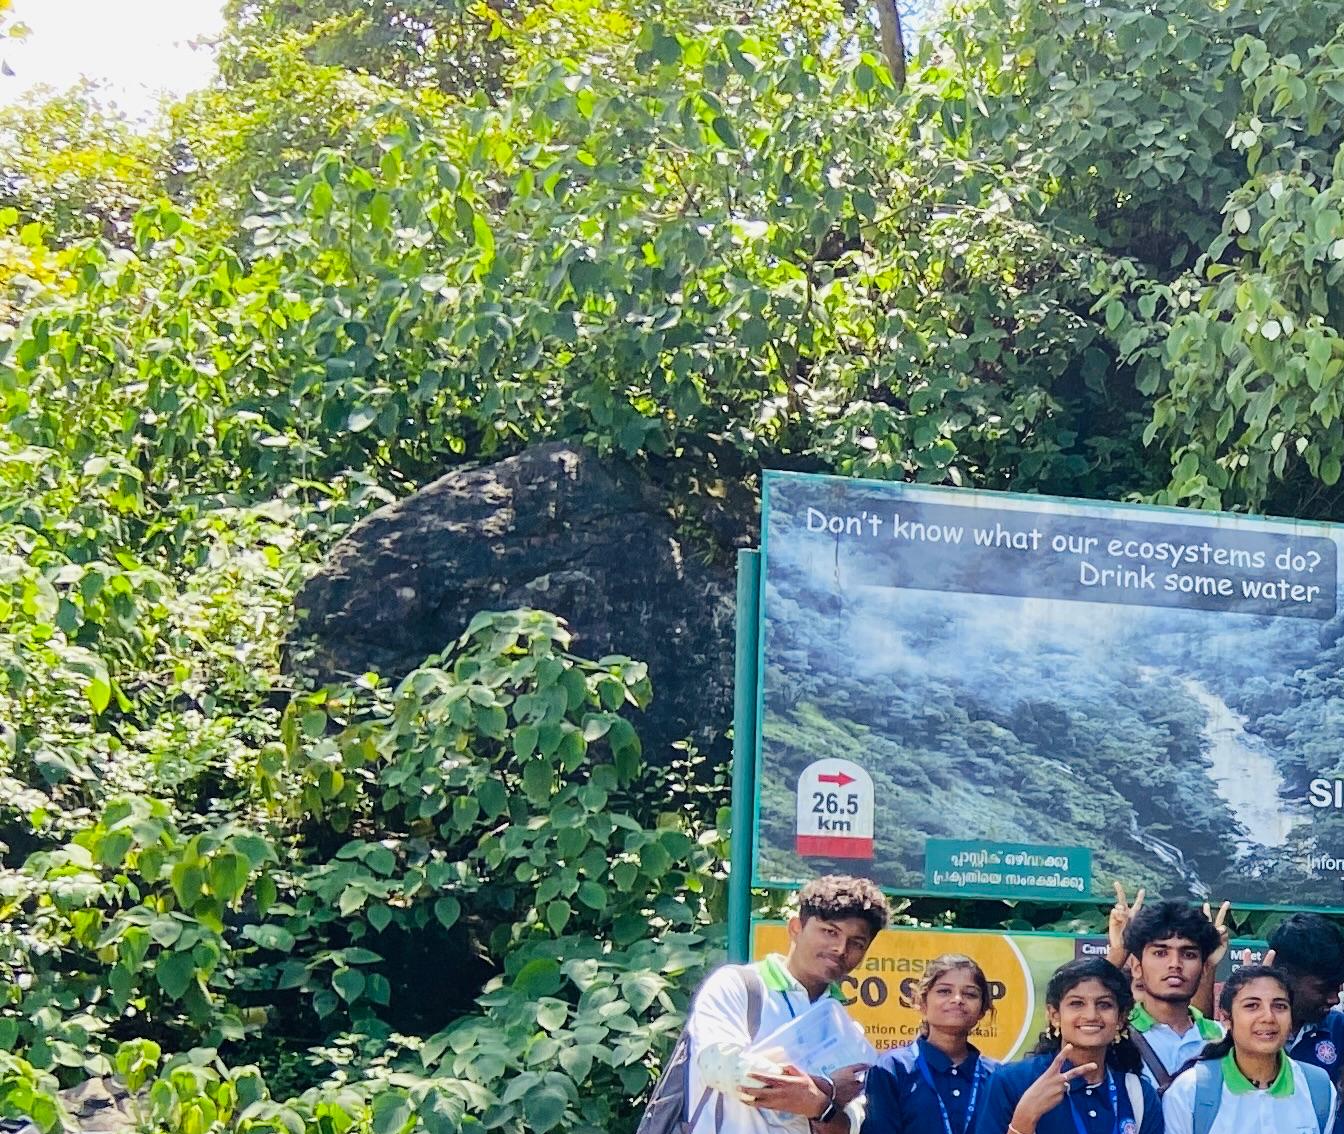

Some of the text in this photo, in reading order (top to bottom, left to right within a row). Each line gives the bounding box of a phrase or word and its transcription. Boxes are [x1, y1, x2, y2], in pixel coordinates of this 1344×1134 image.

[807, 507, 1321, 573] Don't know what our ecosystems do?
[1080, 561, 1320, 602] Drink some water
[812, 791, 858, 815] 26.5
[817, 815, 851, 831] km
